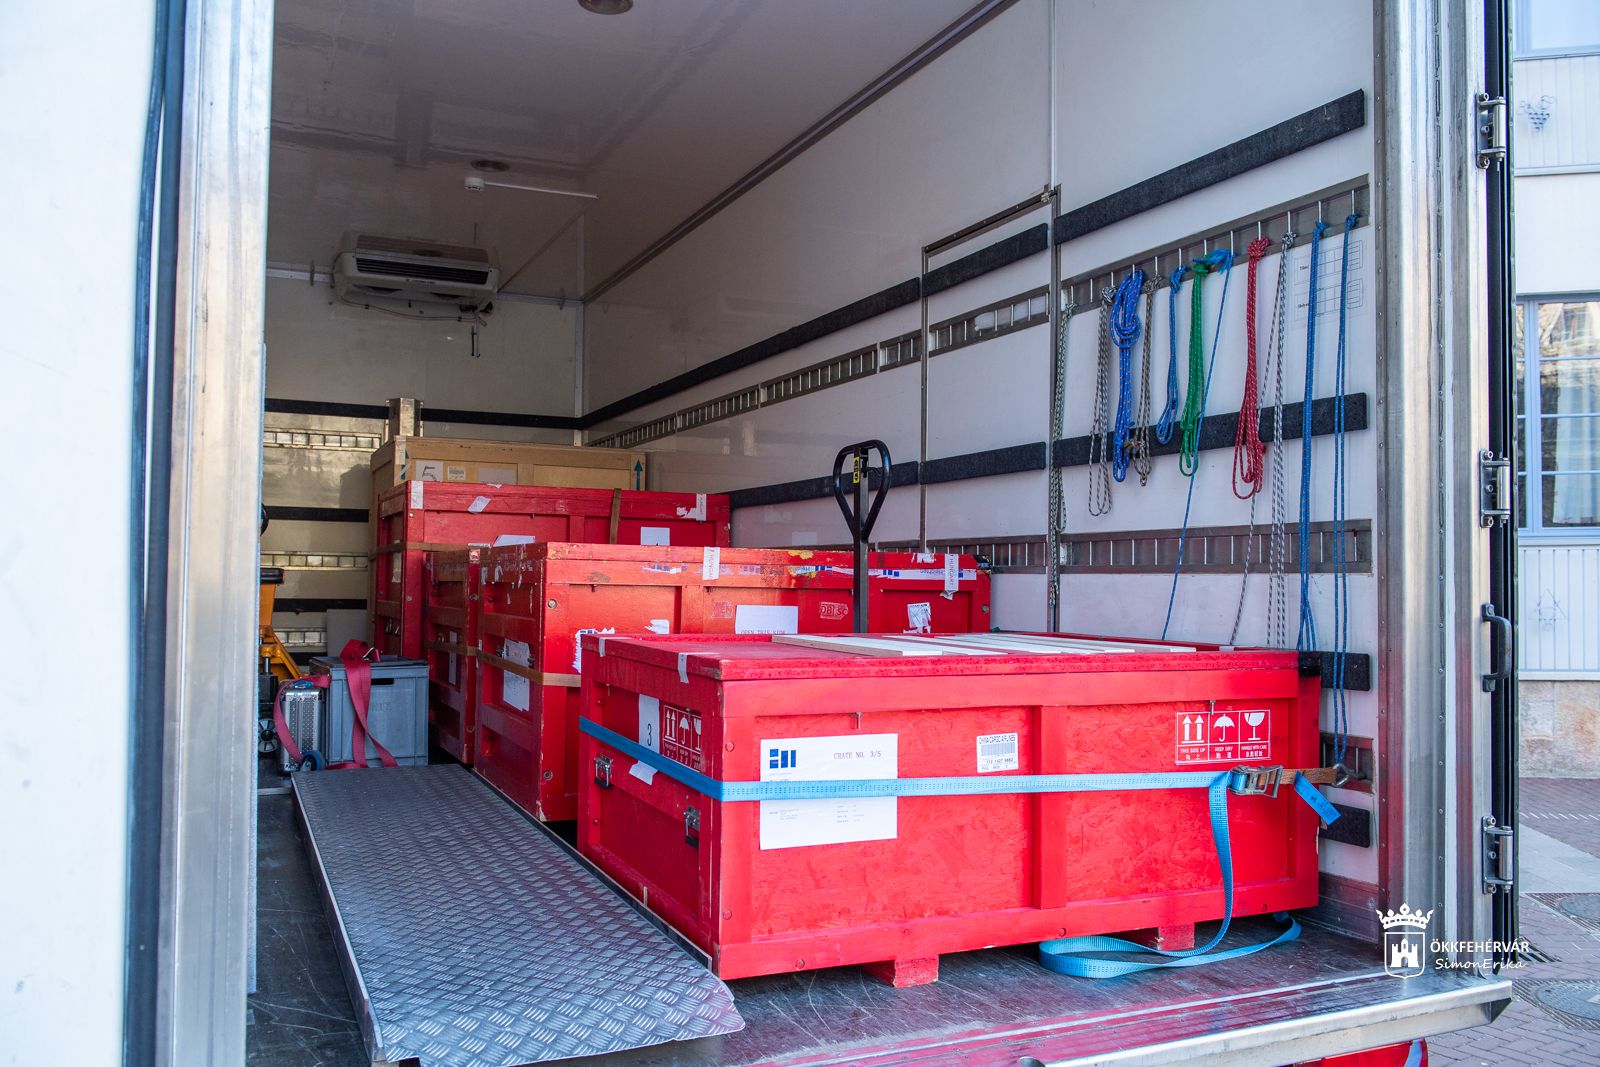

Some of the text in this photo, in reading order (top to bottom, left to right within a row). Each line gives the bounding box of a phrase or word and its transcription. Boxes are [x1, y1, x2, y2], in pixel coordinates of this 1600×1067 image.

[422, 466, 437, 482] 5
[647, 723, 652, 747] 3
[833, 752, 853, 760] CRATE
[869, 750, 882, 758] 3/5
